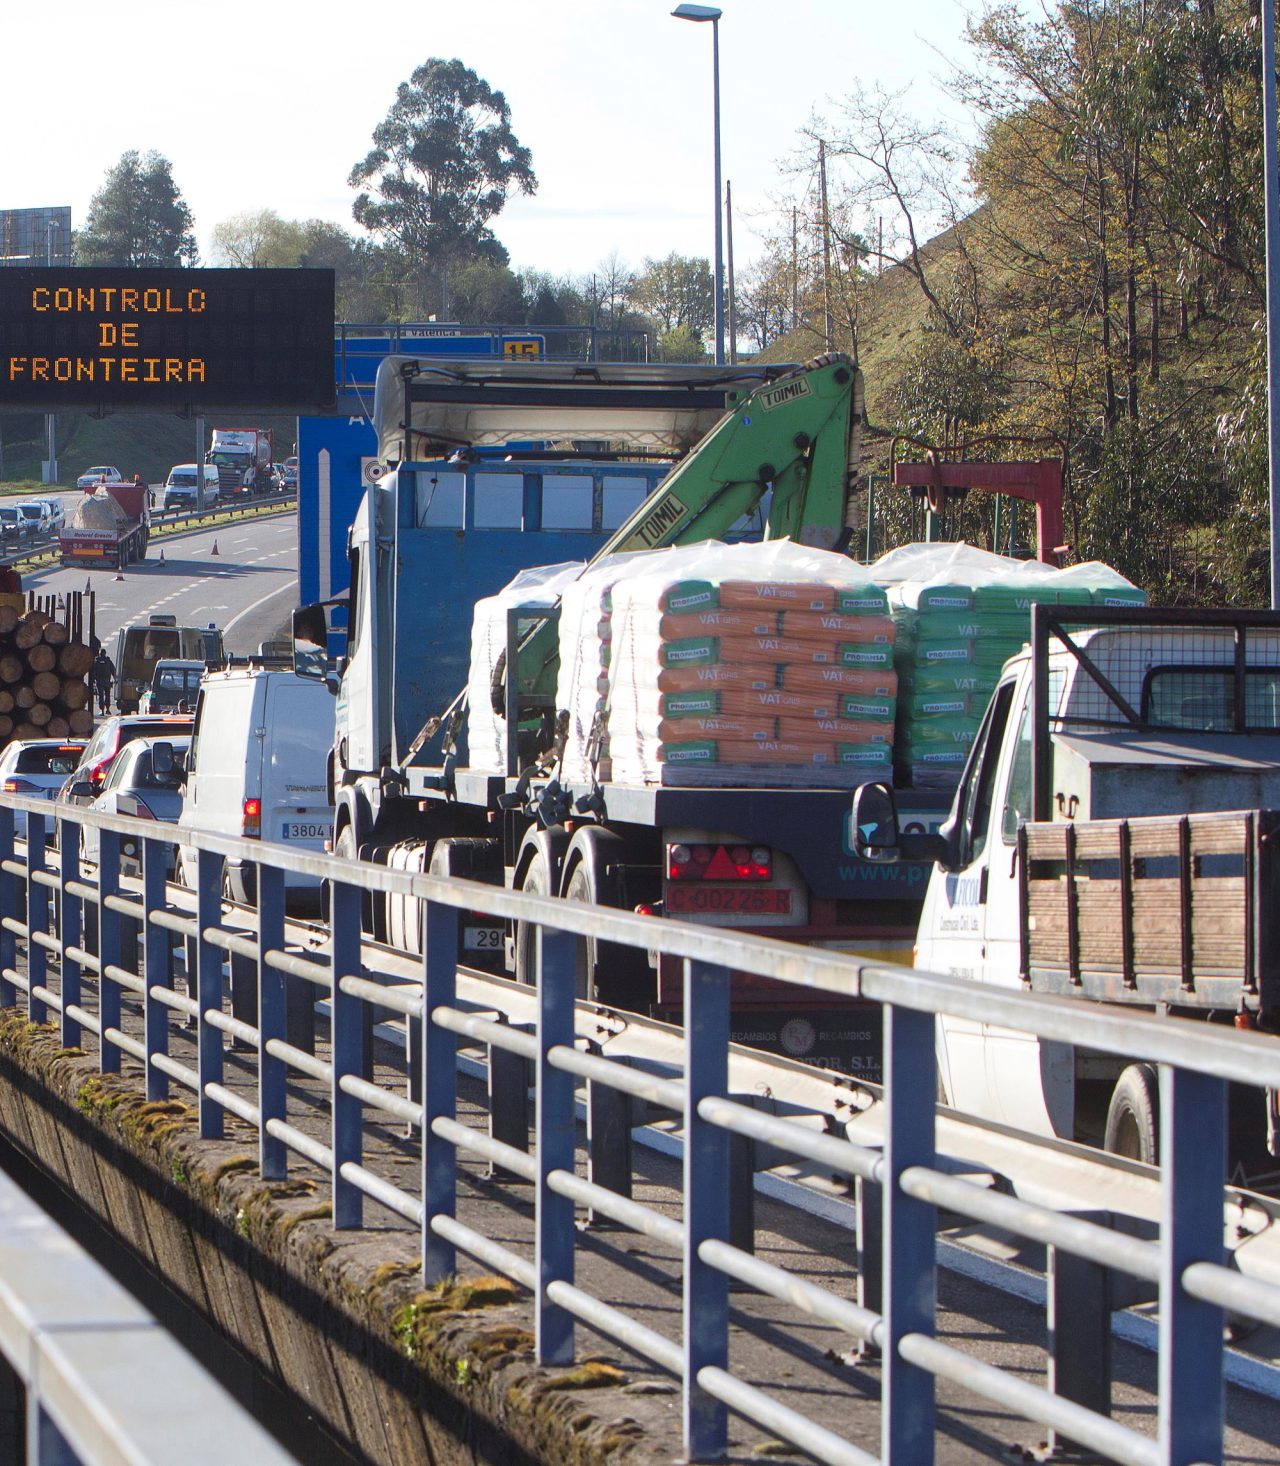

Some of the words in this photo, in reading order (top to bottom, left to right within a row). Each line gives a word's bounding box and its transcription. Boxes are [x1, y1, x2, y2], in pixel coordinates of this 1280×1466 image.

[32, 287, 207, 312] CONTROLO
[99, 323, 139, 348] DE
[9, 357, 207, 383] FRONTEIRA
[765, 380, 807, 406] TOIMIL
[635, 499, 685, 548] TOIMIL
[756, 586, 779, 597] VAT
[699, 615, 721, 625] VAT
[821, 617, 844, 628] VAT
[958, 625, 980, 636] VAT
[758, 639, 780, 649] VAT
[697, 670, 720, 681] VAT
[822, 670, 845, 682] VAT
[954, 678, 977, 689] VAT
[759, 694, 781, 705] VAT
[698, 719, 721, 730] VAT
[817, 720, 841, 730] VAT
[292, 825, 324, 837] 3804
[819, 1031, 871, 1040] RECAMBIOS
[851, 1056, 881, 1070] S.L.
